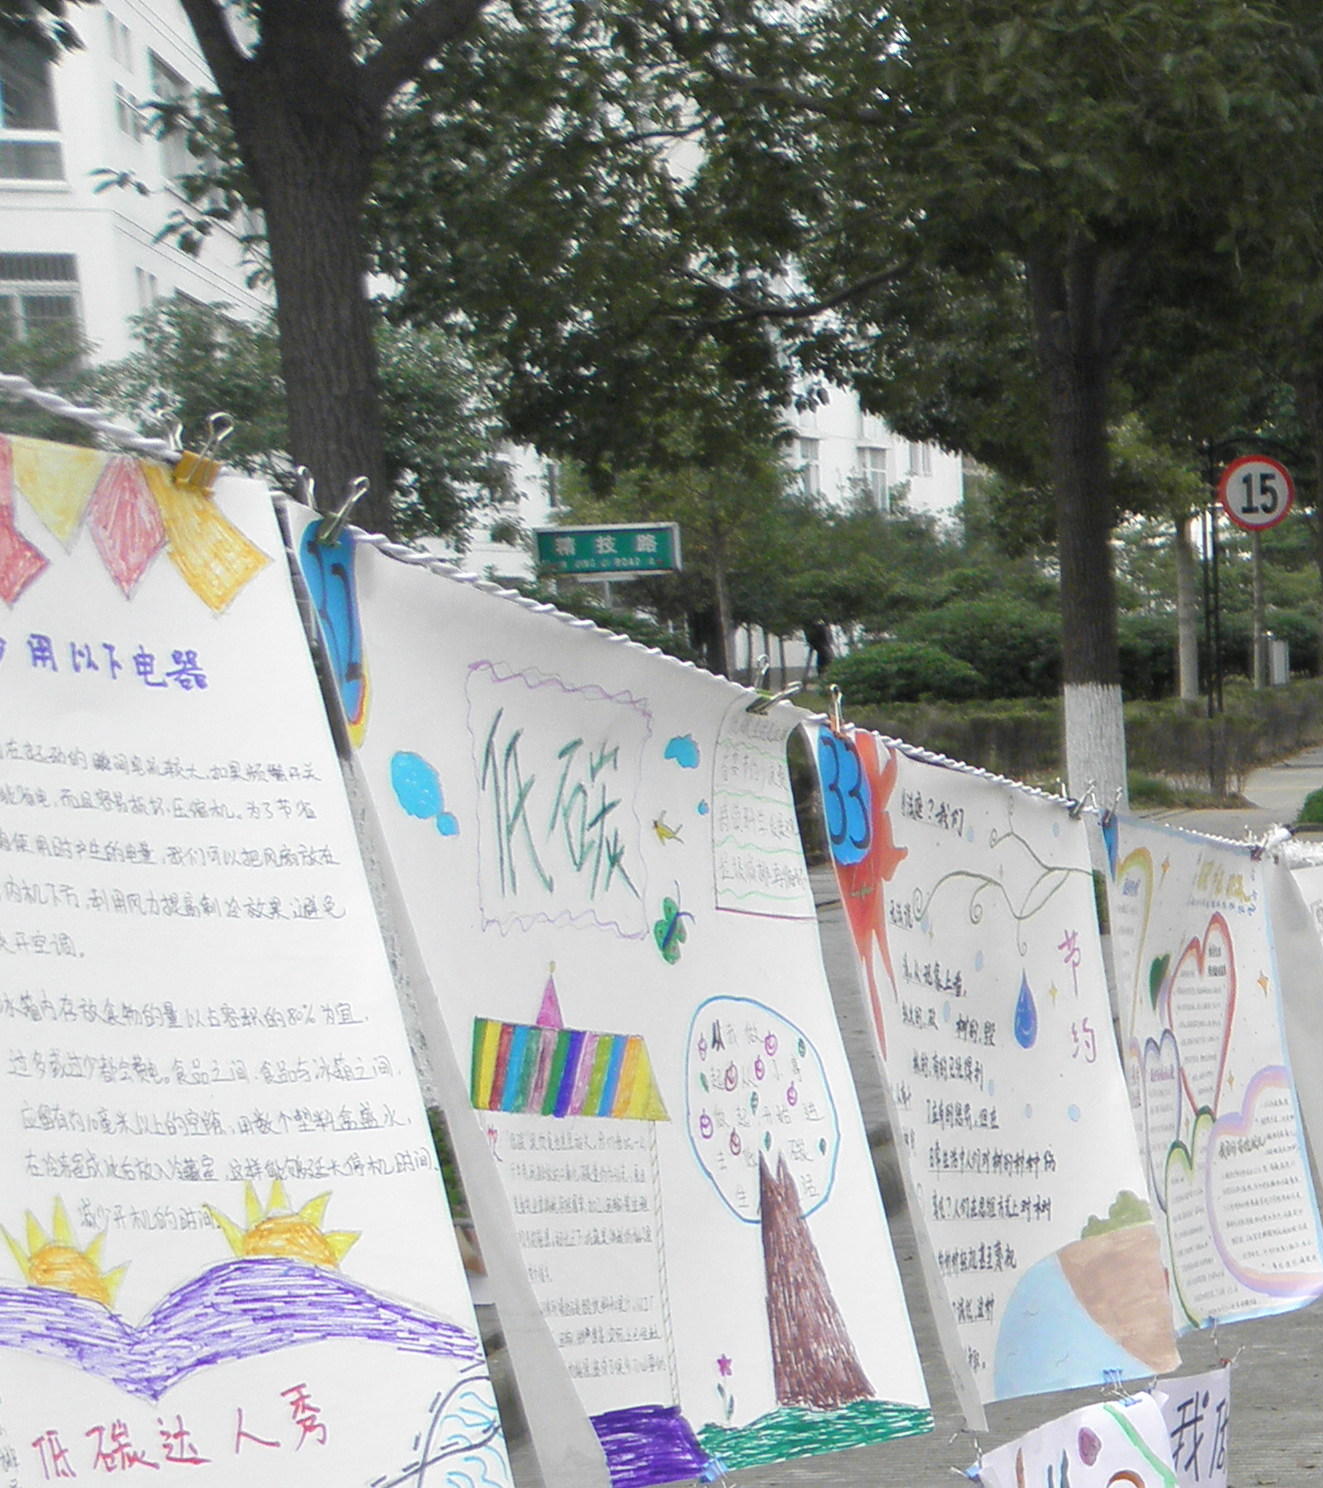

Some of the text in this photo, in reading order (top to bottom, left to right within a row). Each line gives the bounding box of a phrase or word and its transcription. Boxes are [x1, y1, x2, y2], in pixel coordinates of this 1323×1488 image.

[1241, 473, 1279, 515] 15
[0, 633, 209, 690] 用以下电器
[481, 706, 641, 900] 低碳
[821, 735, 871, 850] 33
[32, 1383, 328, 1480] 低碳达人秀
